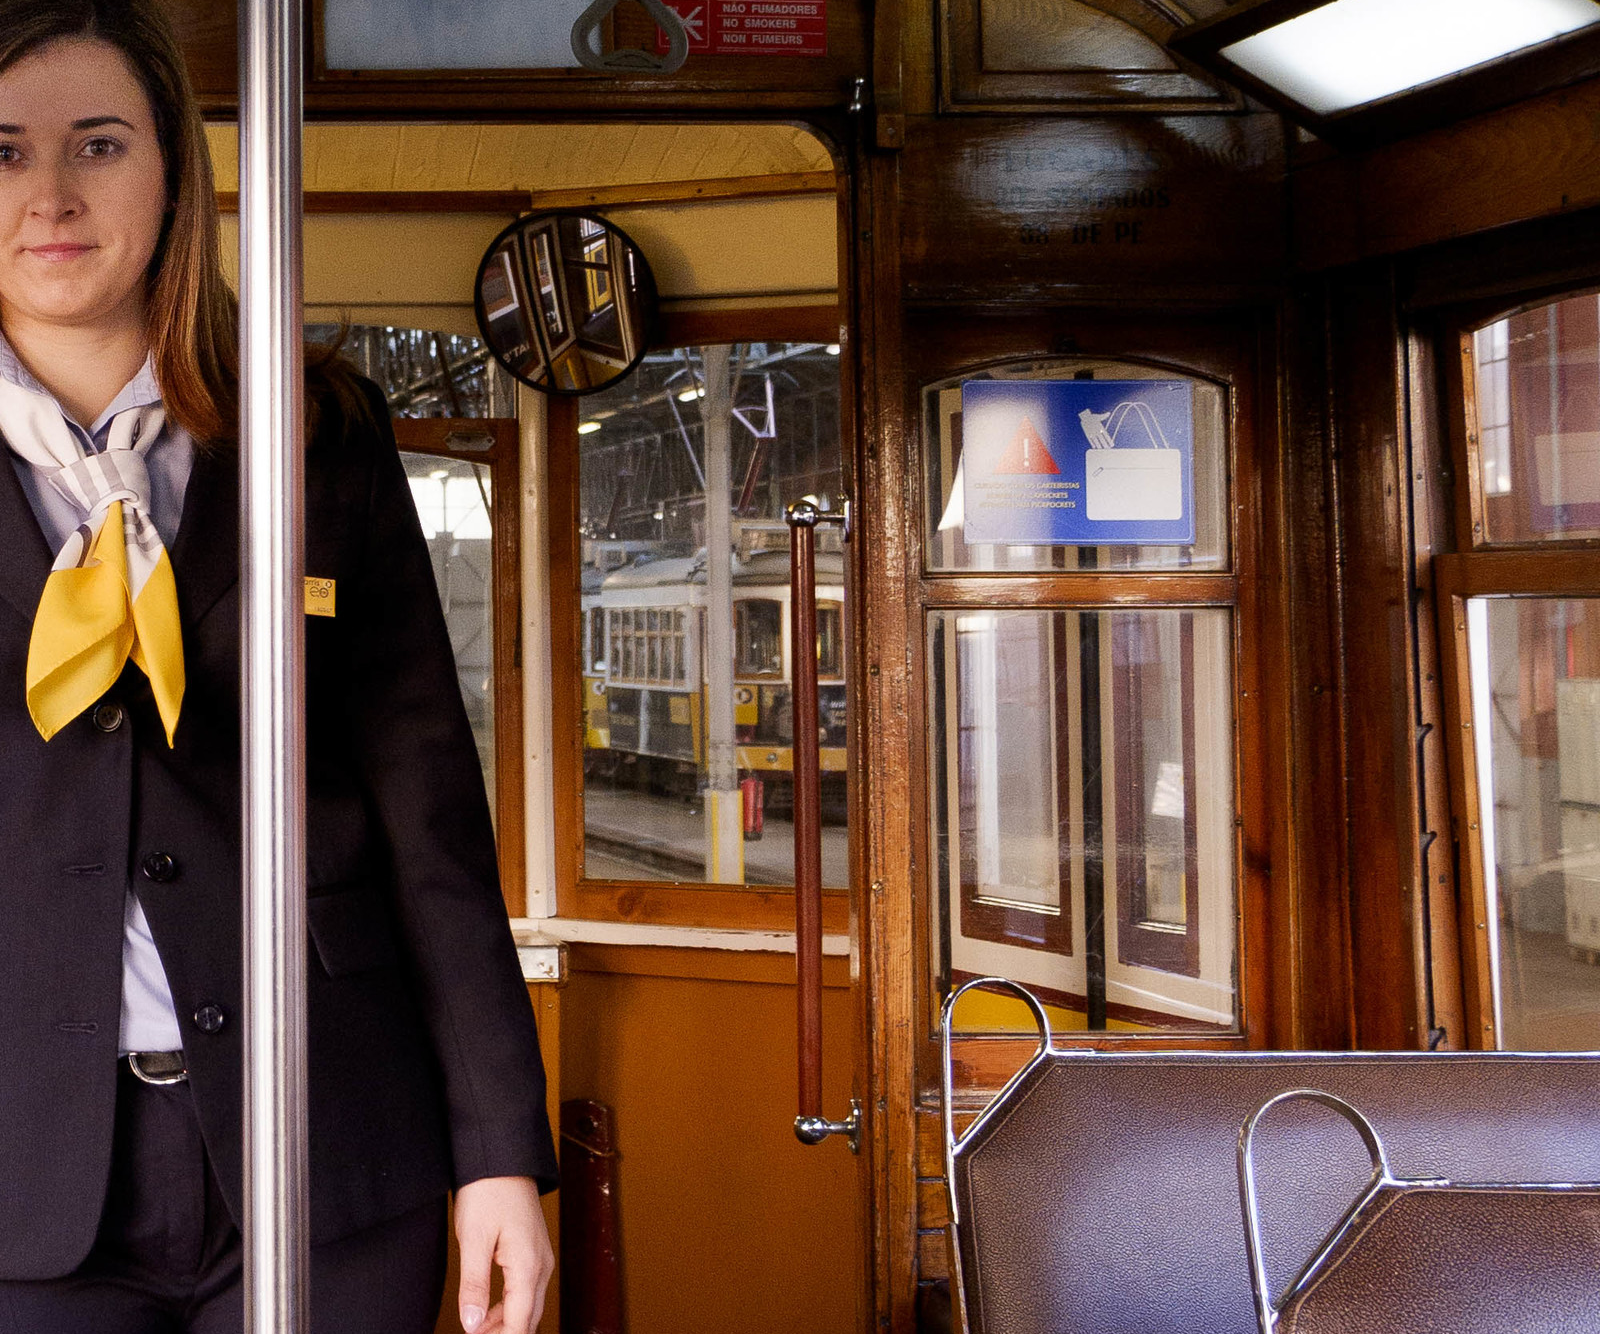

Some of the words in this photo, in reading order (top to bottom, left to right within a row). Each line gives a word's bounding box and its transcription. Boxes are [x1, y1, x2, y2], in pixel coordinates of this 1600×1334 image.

[751, 4, 818, 15] FUMADORES
[722, 18, 739, 28] NO
[744, 18, 797, 28] SMOKERS
[722, 34, 746, 43] NON
[752, 34, 803, 44] FUMEURS
[1072, 222, 1102, 245] DE
